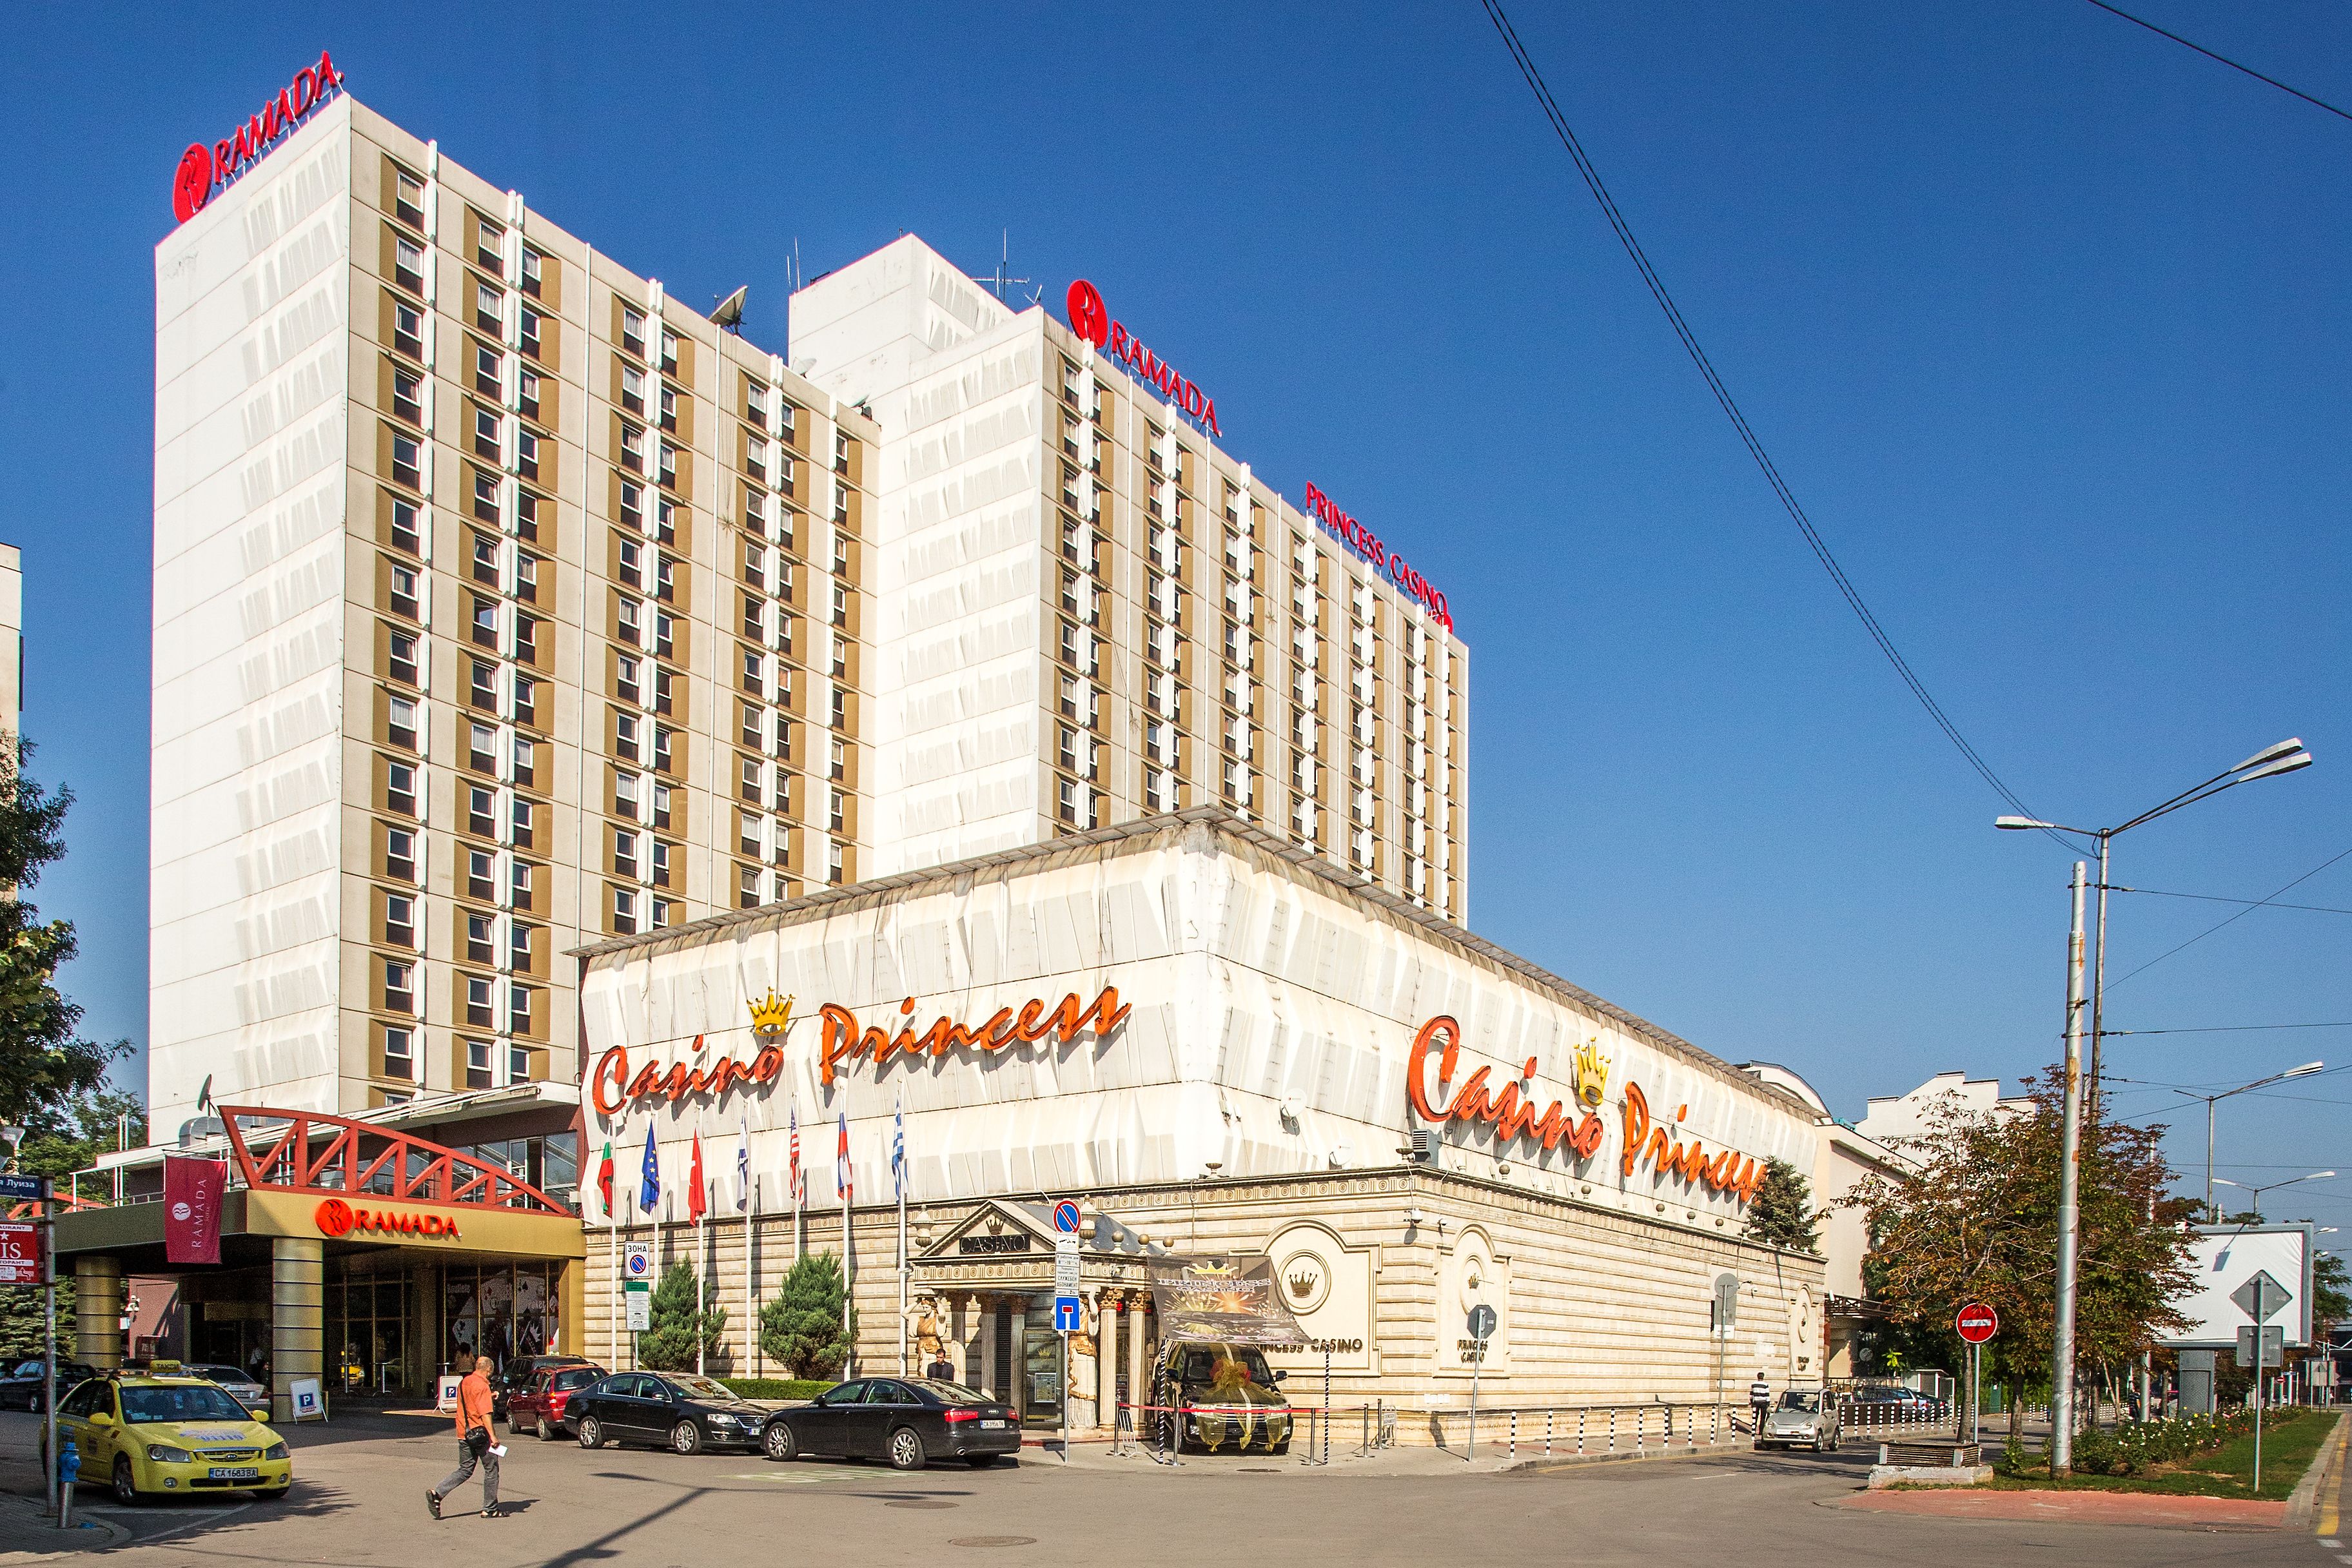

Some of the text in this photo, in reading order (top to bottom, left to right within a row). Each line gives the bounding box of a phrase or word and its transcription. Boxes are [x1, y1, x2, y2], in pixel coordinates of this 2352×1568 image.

[213, 50, 337, 185] RAMADA
[1111, 320, 1220, 437] RAMADA
[1306, 481, 1447, 614] PRINCESS CASINO
[592, 986, 1132, 1115] Casino Princess
[1408, 1015, 1603, 1160] Casino
[6, 1179, 35, 1188] Луиза
[191, 1179, 207, 1248] RAMADA
[1, 1242, 21, 1259] IS
[355, 1209, 459, 1237] RAMADA
[960, 1235, 1026, 1253] CASINO
[1157, 1279, 1272, 1288] PRINCESS
